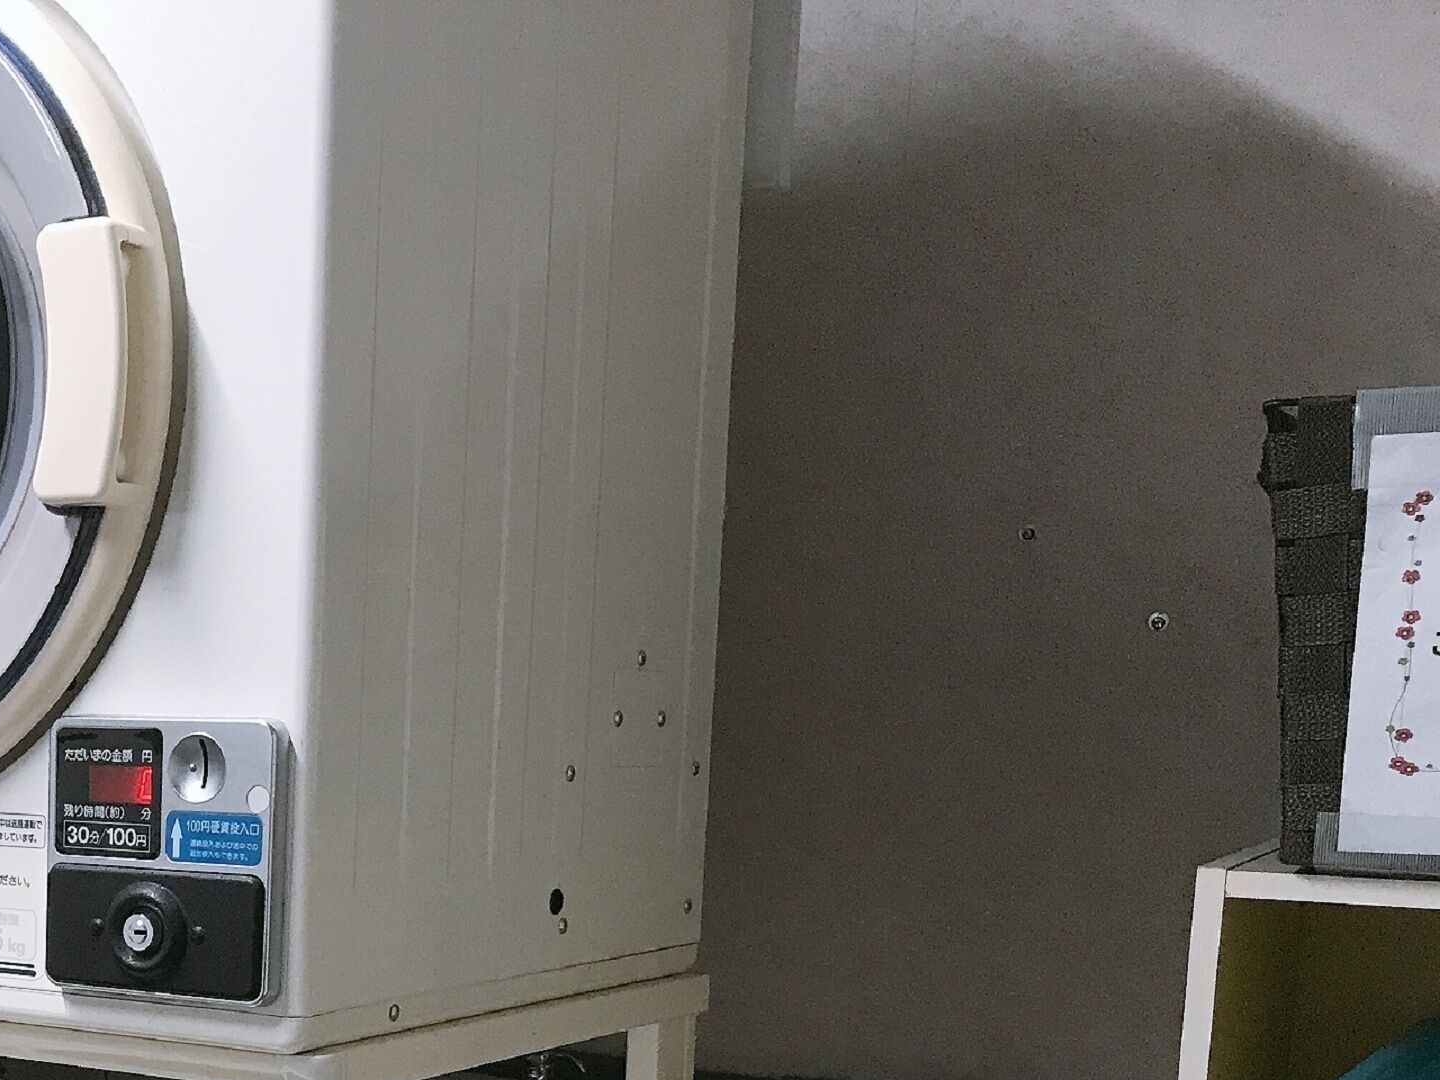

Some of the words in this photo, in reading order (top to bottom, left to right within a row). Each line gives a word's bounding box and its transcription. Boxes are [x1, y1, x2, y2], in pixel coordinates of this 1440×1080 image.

[64, 748, 133, 763] ただいまの金額
[141, 749, 153, 763] 円
[63, 804, 125, 820] 残り時間(約)
[140, 808, 152, 821] 分
[186, 820, 260, 835] 100円硬貨投入口
[67, 825, 147, 847] 30分/100円
